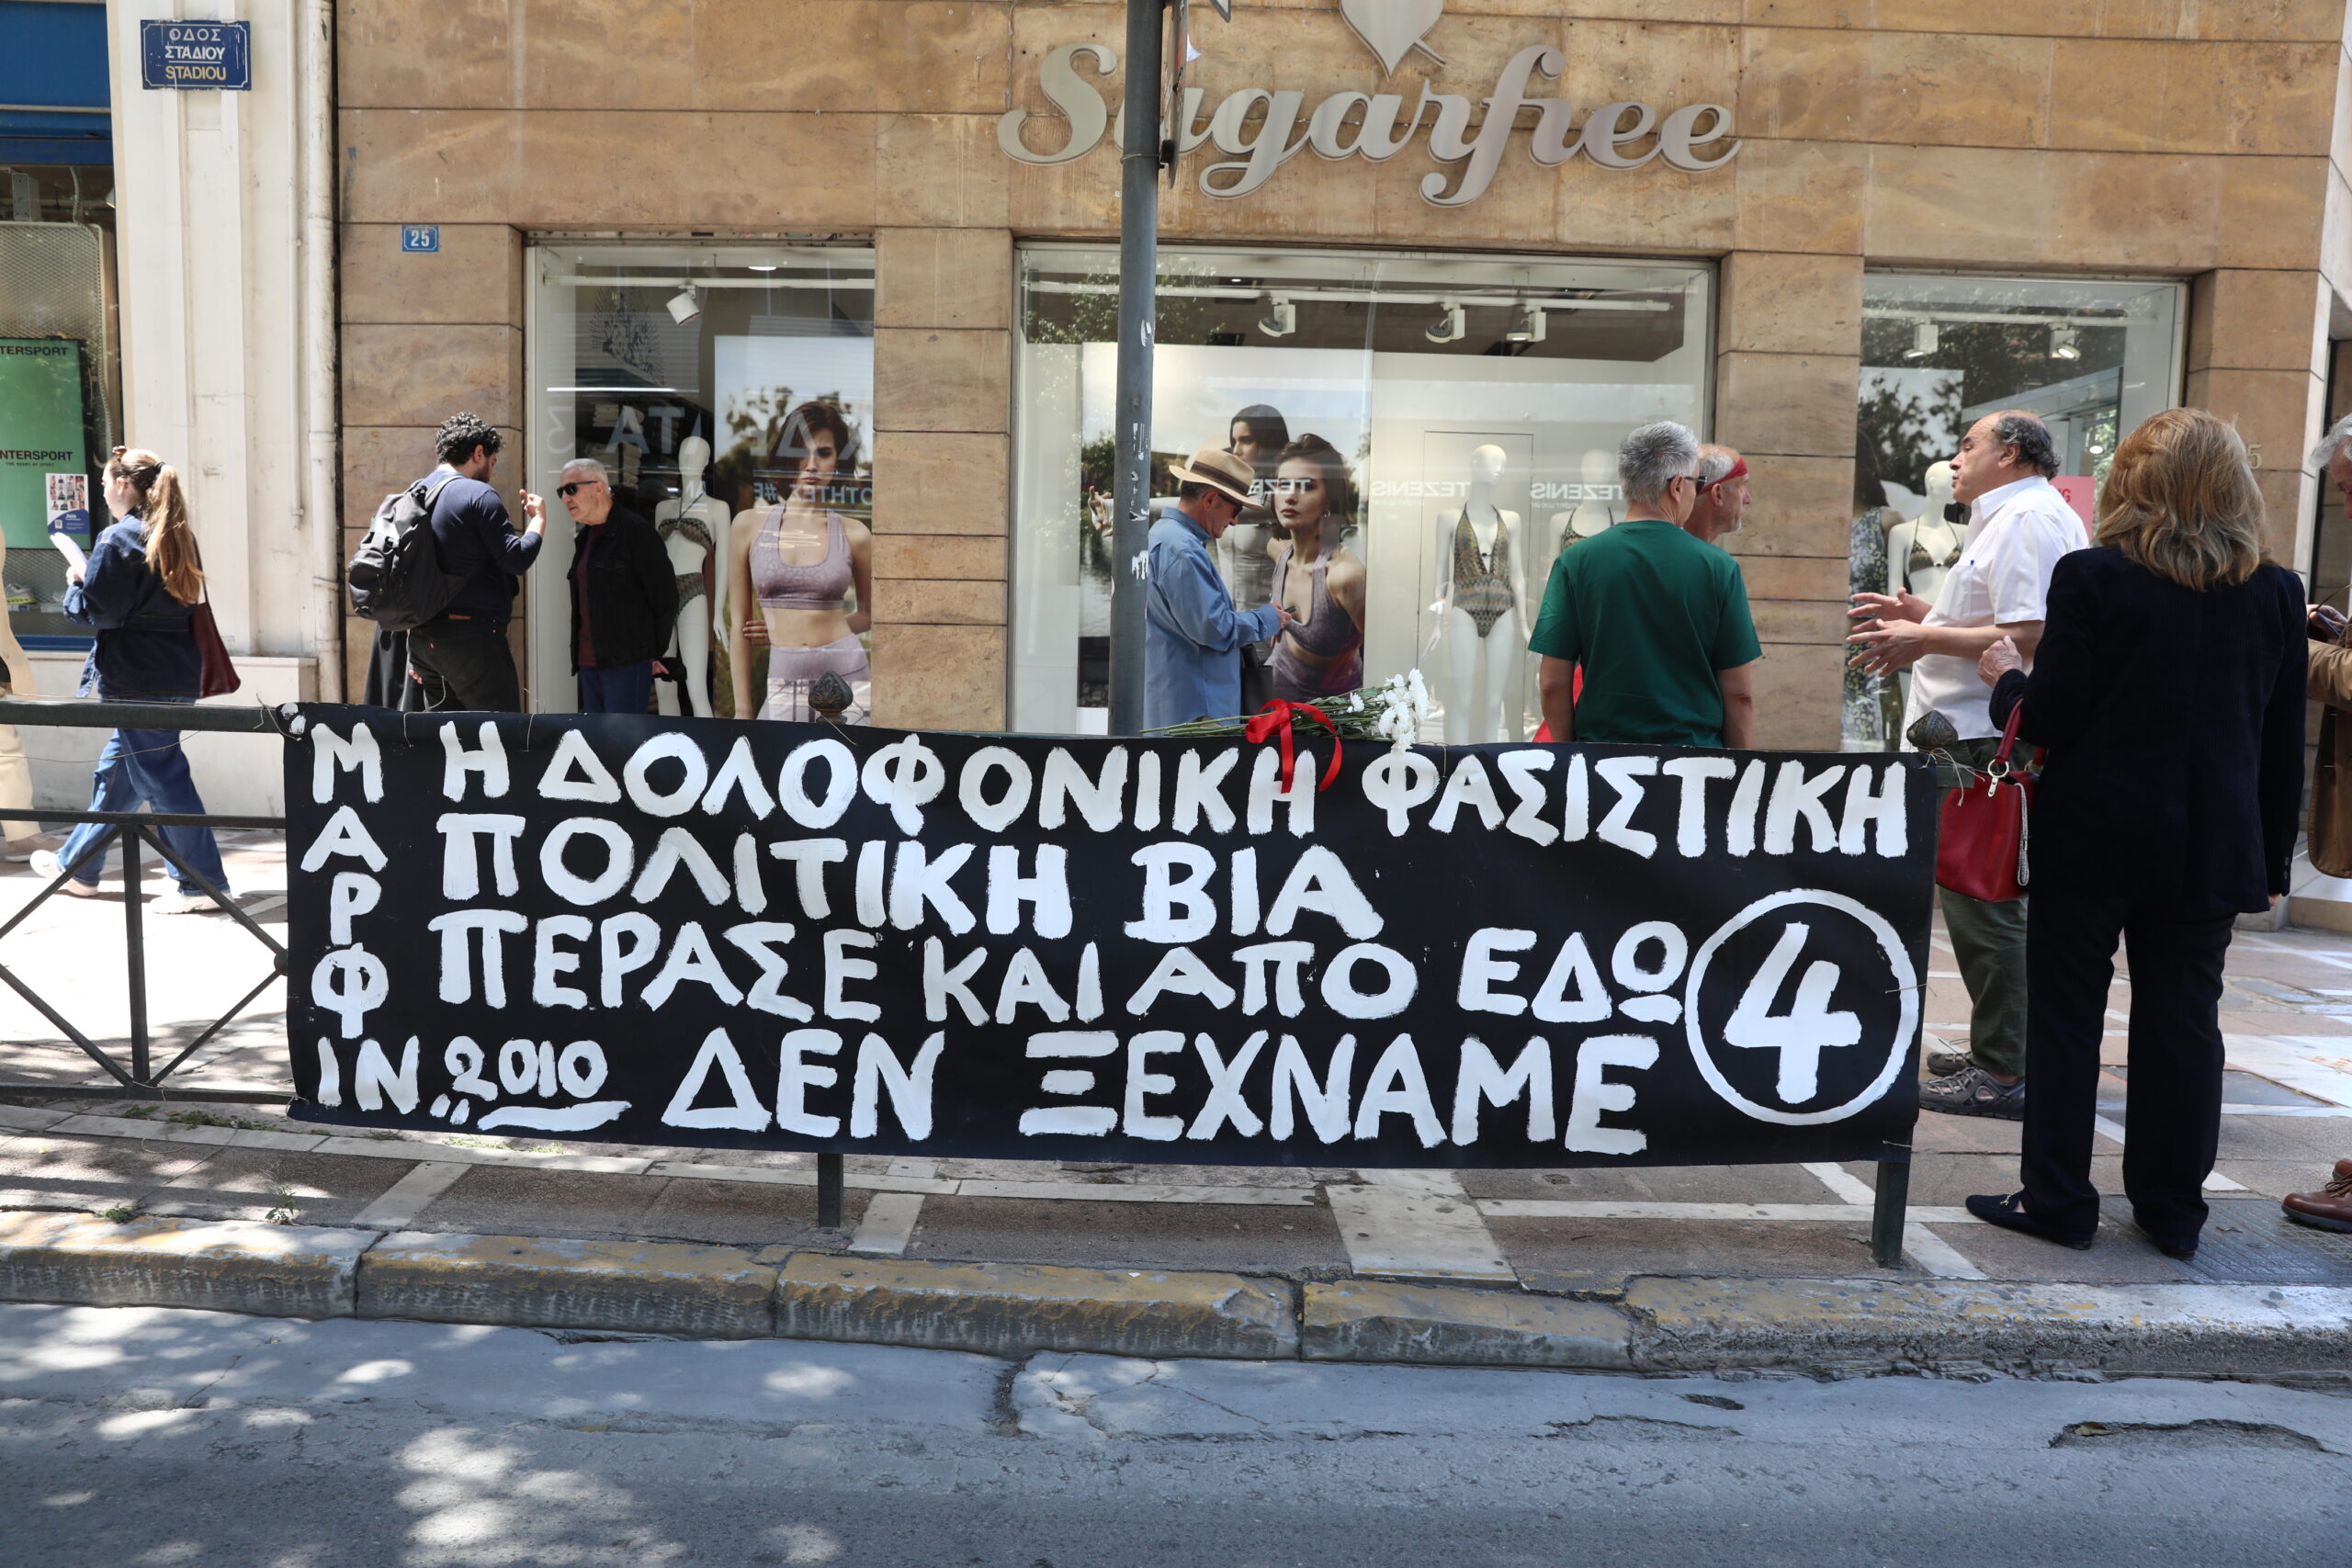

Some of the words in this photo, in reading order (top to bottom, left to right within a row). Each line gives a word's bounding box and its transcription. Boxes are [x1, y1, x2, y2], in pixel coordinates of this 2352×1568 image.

[164, 45, 225, 61] ΣΤΑΔΙΟΥ
[165, 65, 227, 80] STADIOU
[169, 28, 221, 41] ΟΔΟΣ
[411, 229, 430, 247] 25
[440, 721, 509, 802] Η
[537, 729, 1317, 837] ΔΟΛΟΦΟΝΙΚΗ
[1362, 748, 1908, 859] ΦΑΣΙΣΤΙΚΗ
[436, 813, 1072, 939] ΠΟΛΙΤΙΚΗ
[1125, 841, 1384, 943] ΒΙΑ
[428, 909, 881, 1022] ΠΕΡΑΣΕ
[923, 936, 1103, 1026] ΚΑΙ
[1126, 941, 1417, 1019] ΑΠΟ
[1458, 921, 1689, 1024] ΕΔΩ
[1724, 922, 1861, 1103] 4
[662, 1028, 944, 1140] ΔΕΝ
[1019, 1030, 1659, 1155] ΞΕΧΝΑΜΕ
